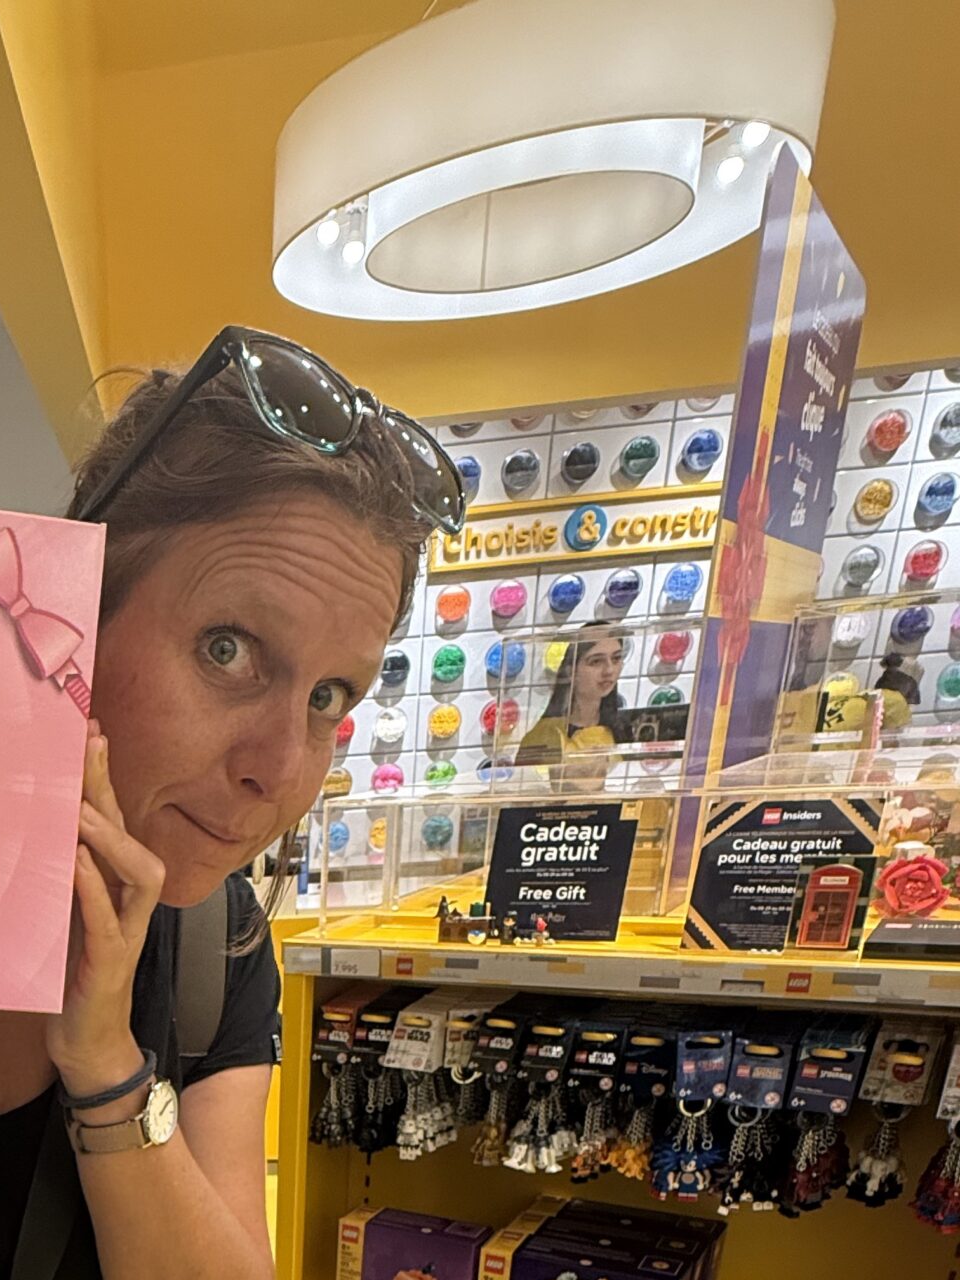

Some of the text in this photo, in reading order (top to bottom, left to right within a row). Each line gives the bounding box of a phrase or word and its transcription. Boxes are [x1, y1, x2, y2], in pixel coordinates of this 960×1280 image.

[576, 509, 601, 544] &
[782, 811, 822, 821] Insiders
[520, 820, 608, 842] Cadeau
[732, 836, 843, 855] Cadeau gratuit
[520, 840, 600, 867] gratuit
[717, 852, 752, 866] pour
[754, 851, 777, 863] les
[518, 885, 587, 900] Free Gift
[733, 884, 755, 895] Free
[789, 979, 809, 988] LEGO
[640, 1062, 669, 1077] Disney
[568, 1078, 579, 1087] 6+
[678, 1087, 692, 1097] 6+
[729, 1091, 742, 1101] 6+
[791, 1097, 806, 1107] 6+
